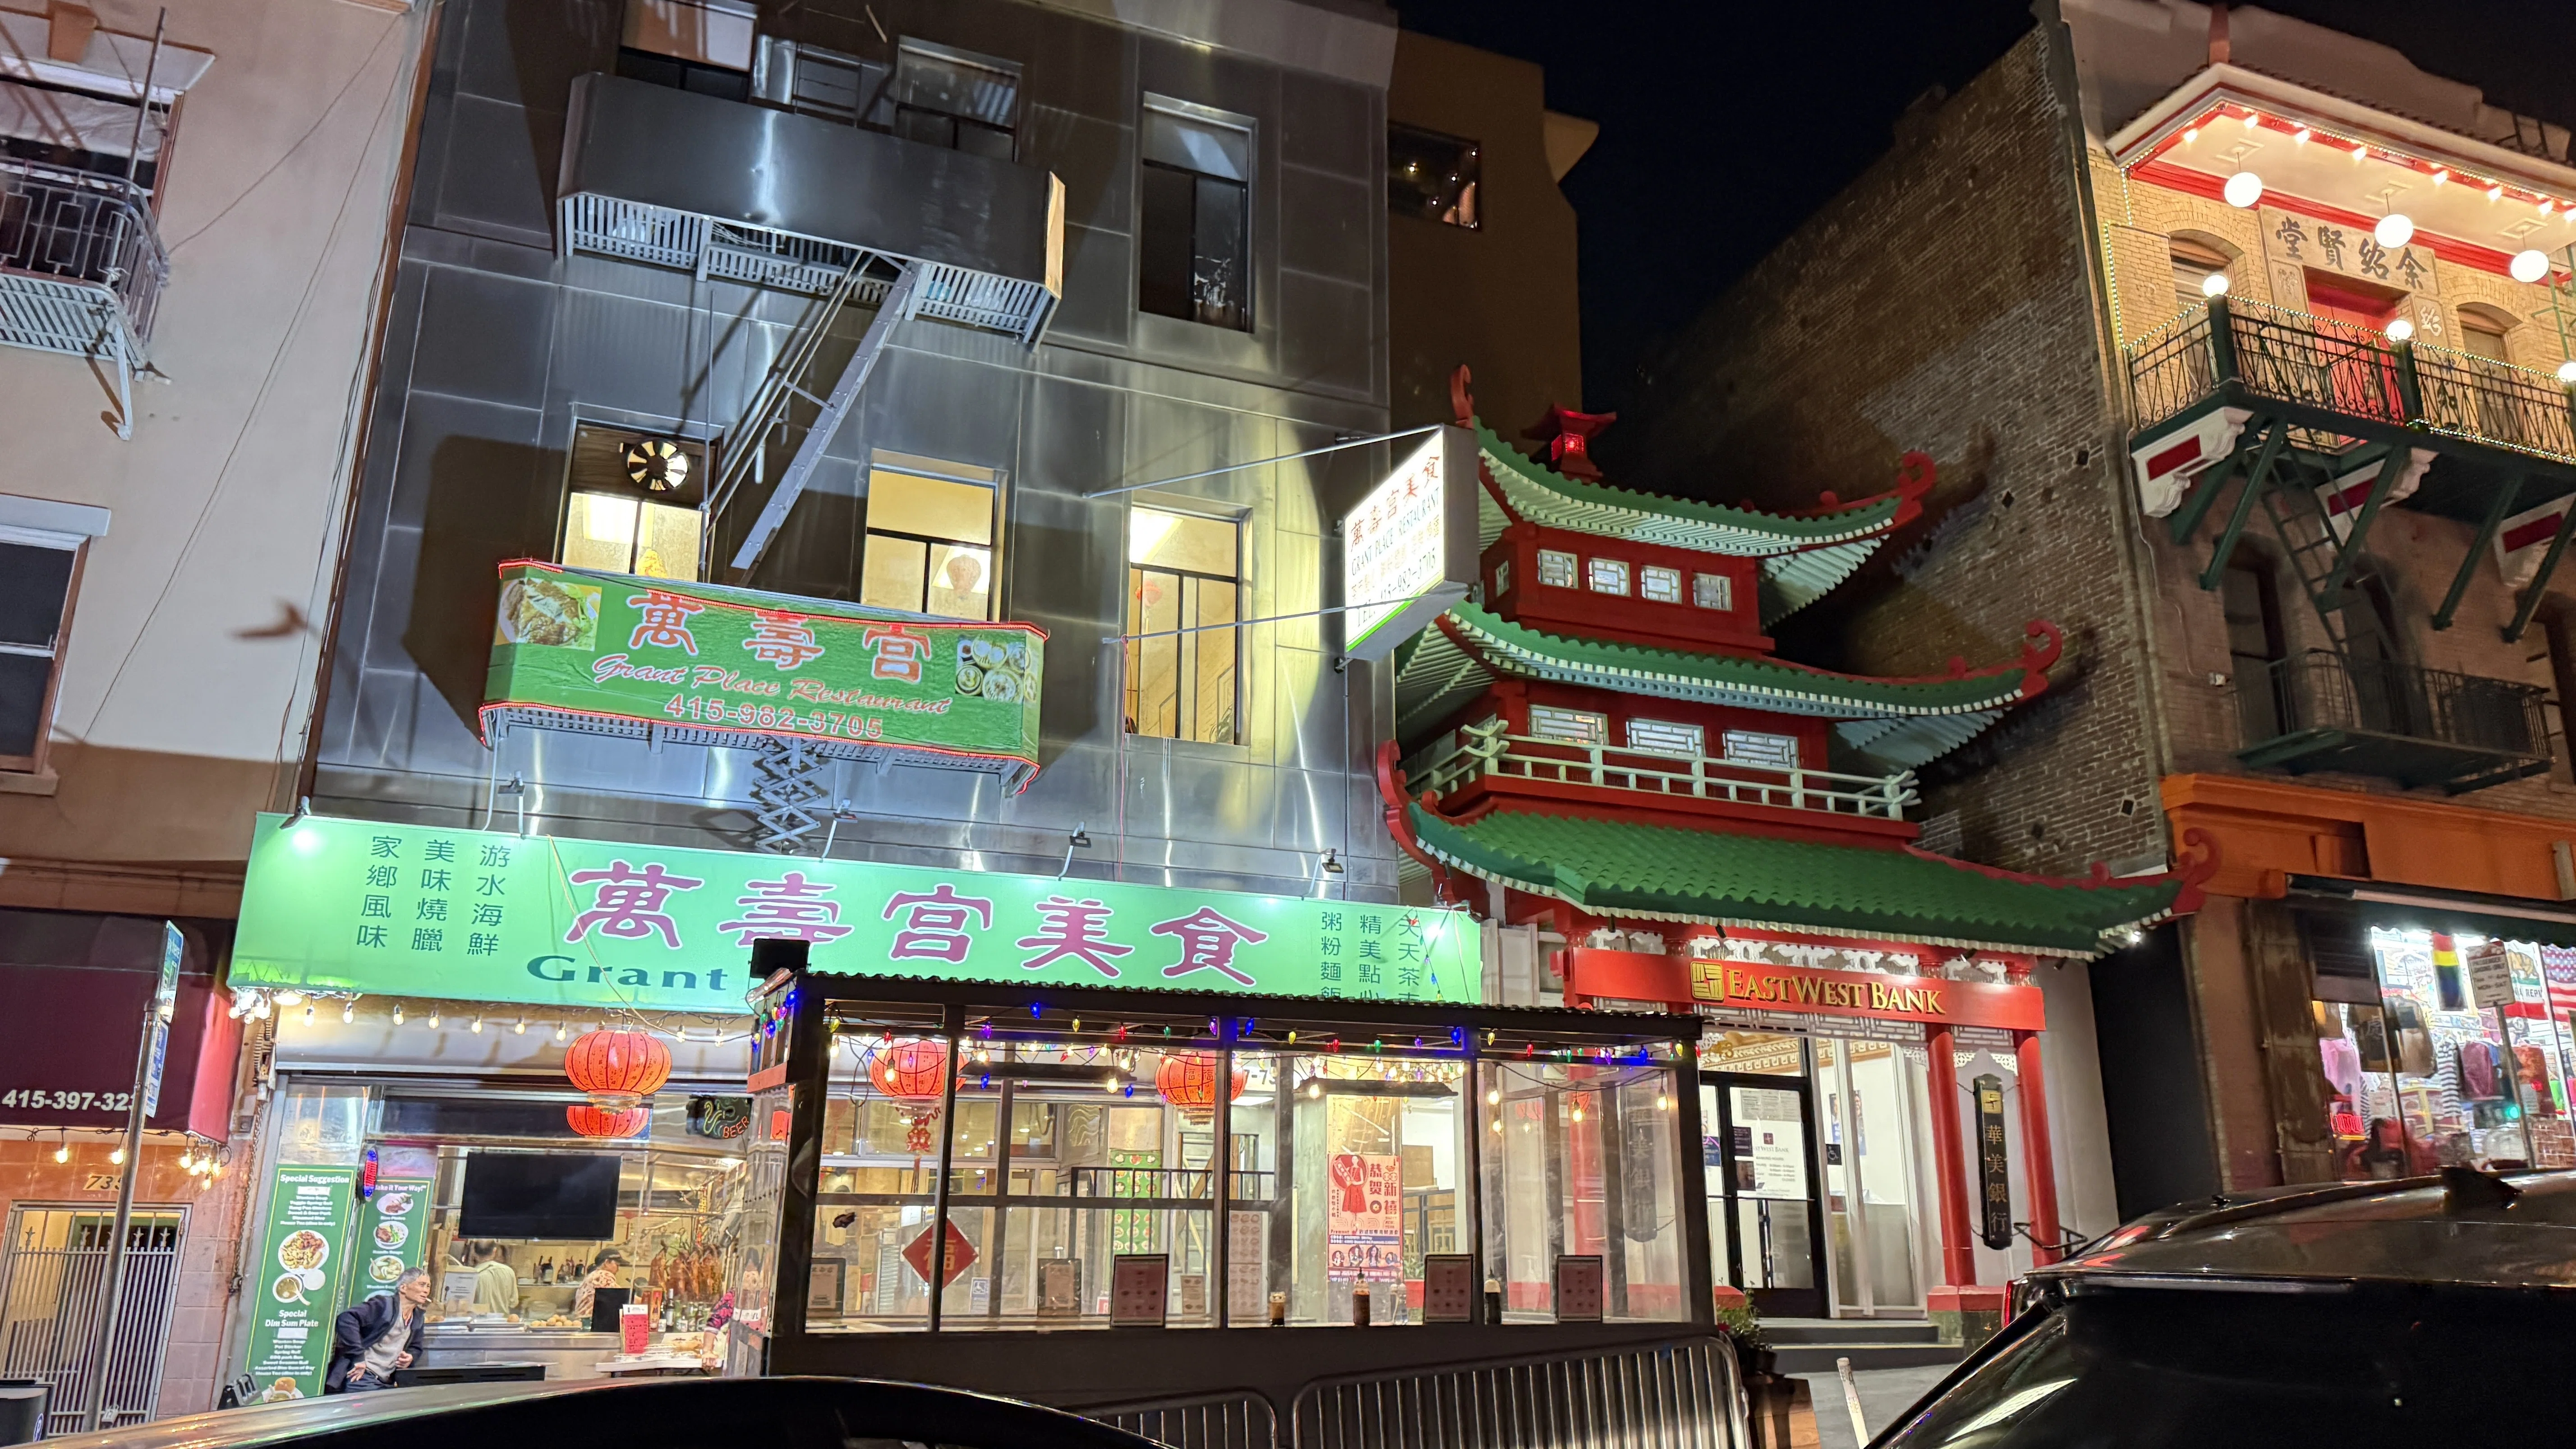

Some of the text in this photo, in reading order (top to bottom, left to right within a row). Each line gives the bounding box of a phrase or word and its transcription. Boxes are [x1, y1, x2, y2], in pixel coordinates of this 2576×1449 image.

[626, 590, 932, 683] 萬壽宮
[592, 653, 953, 713] Grant Place Restaurant
[664, 694, 883, 739] 415-982-3705
[357, 836, 402, 948] 家鄉風味
[411, 839, 455, 952] 美味燒臘
[467, 845, 511, 956] 游水海鮮
[563, 859, 1268, 987] 萬壽宮美食
[527, 955, 728, 991] Grant
[1868, 982, 1946, 1015] BANK
[723, 1116, 749, 1138] BEER
[280, 1174, 350, 1184] Special Suggestion
[1986, 1125, 2007, 1232] 華美銀行
[279, 1310, 307, 1318] Special
